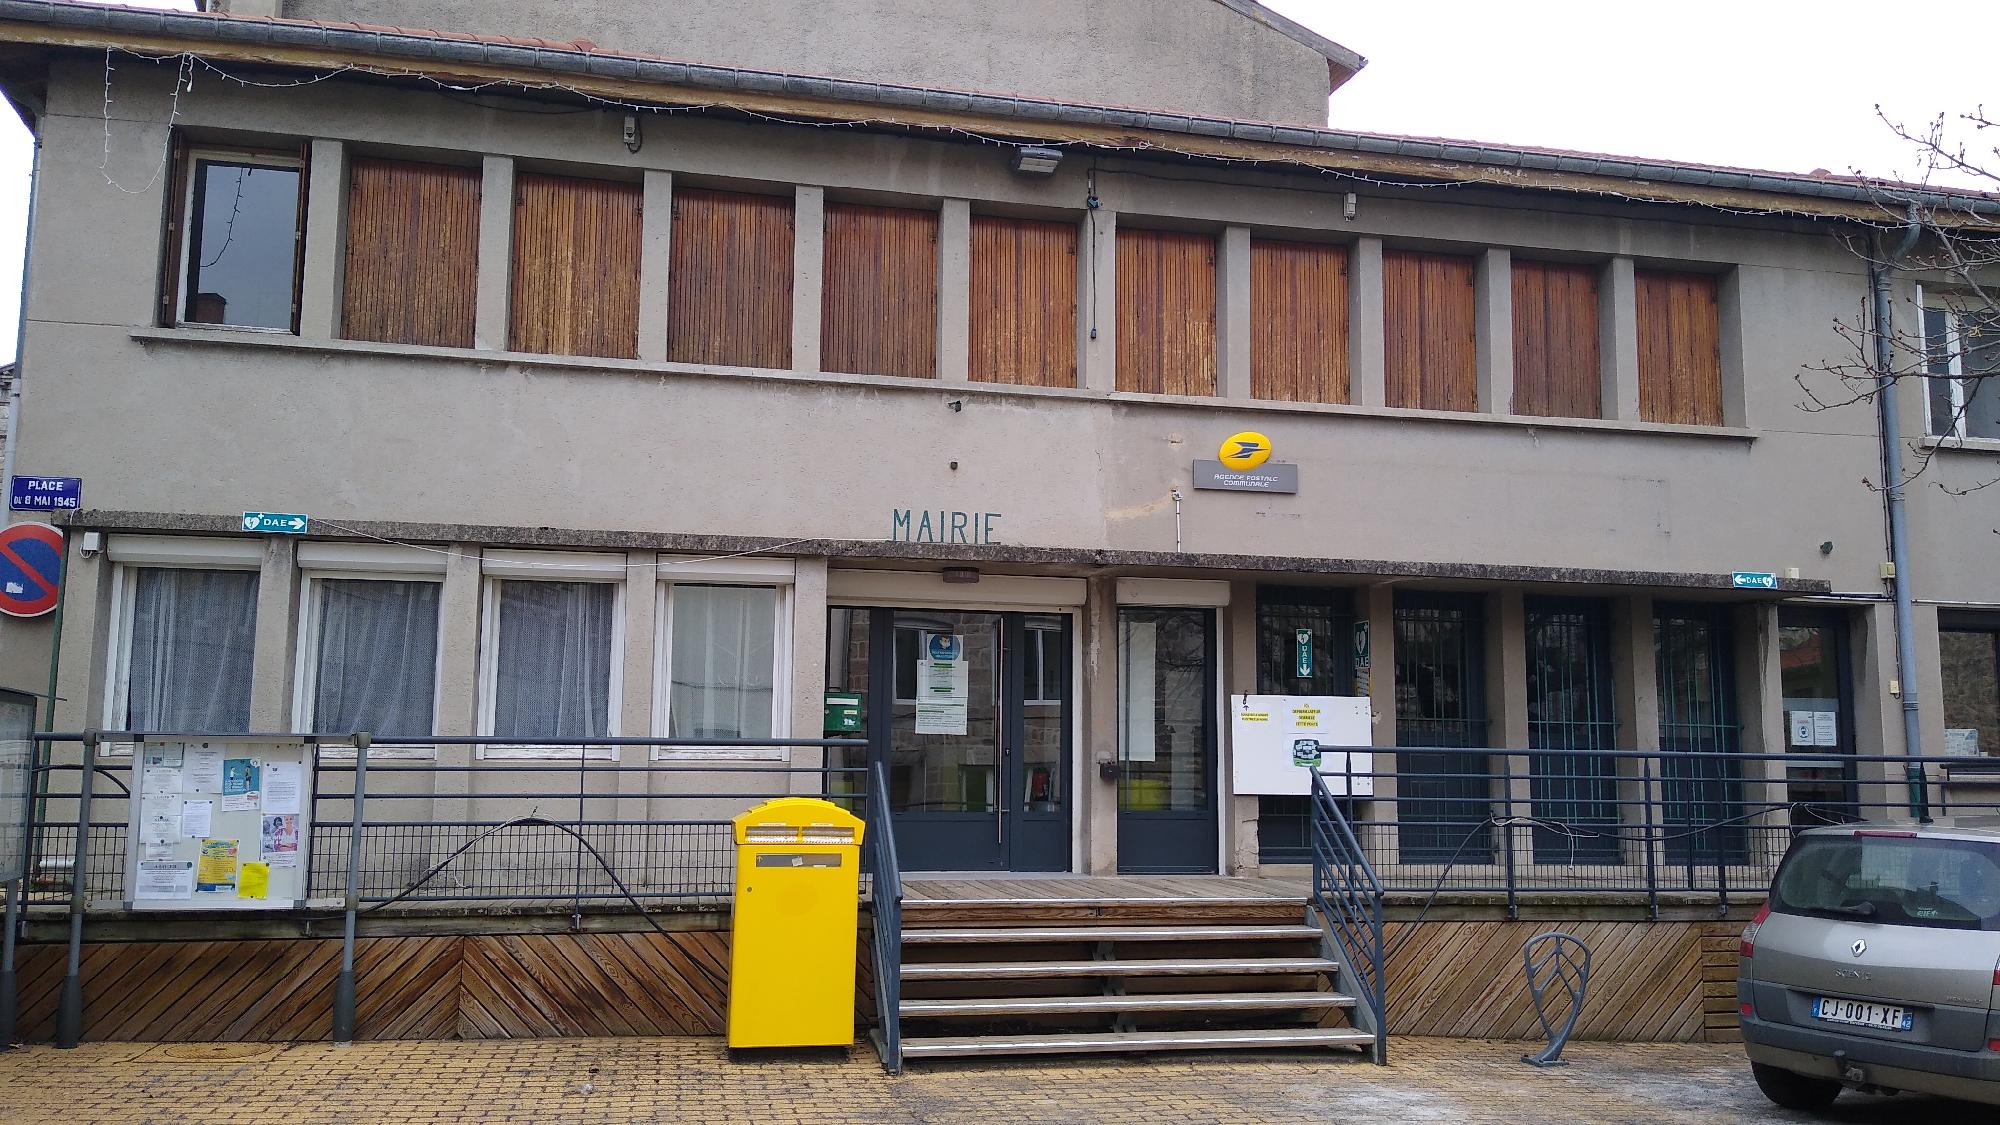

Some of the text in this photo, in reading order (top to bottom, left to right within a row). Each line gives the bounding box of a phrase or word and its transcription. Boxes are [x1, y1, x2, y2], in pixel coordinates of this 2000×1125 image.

[27, 480, 64, 491] PLACE
[1223, 480, 1269, 488] COMMUNALE
[24, 495, 31, 505] 8
[34, 495, 51, 506] MAI
[53, 496, 76, 508] 1945
[263, 518, 288, 527] DAE
[892, 508, 1002, 545] MAIRIE
[1746, 576, 1762, 584] DAE
[1355, 656, 1369, 668] DAE
[1821, 1000, 1901, 1025] CJ-001-XF
[1901, 1019, 1911, 1029] 42
